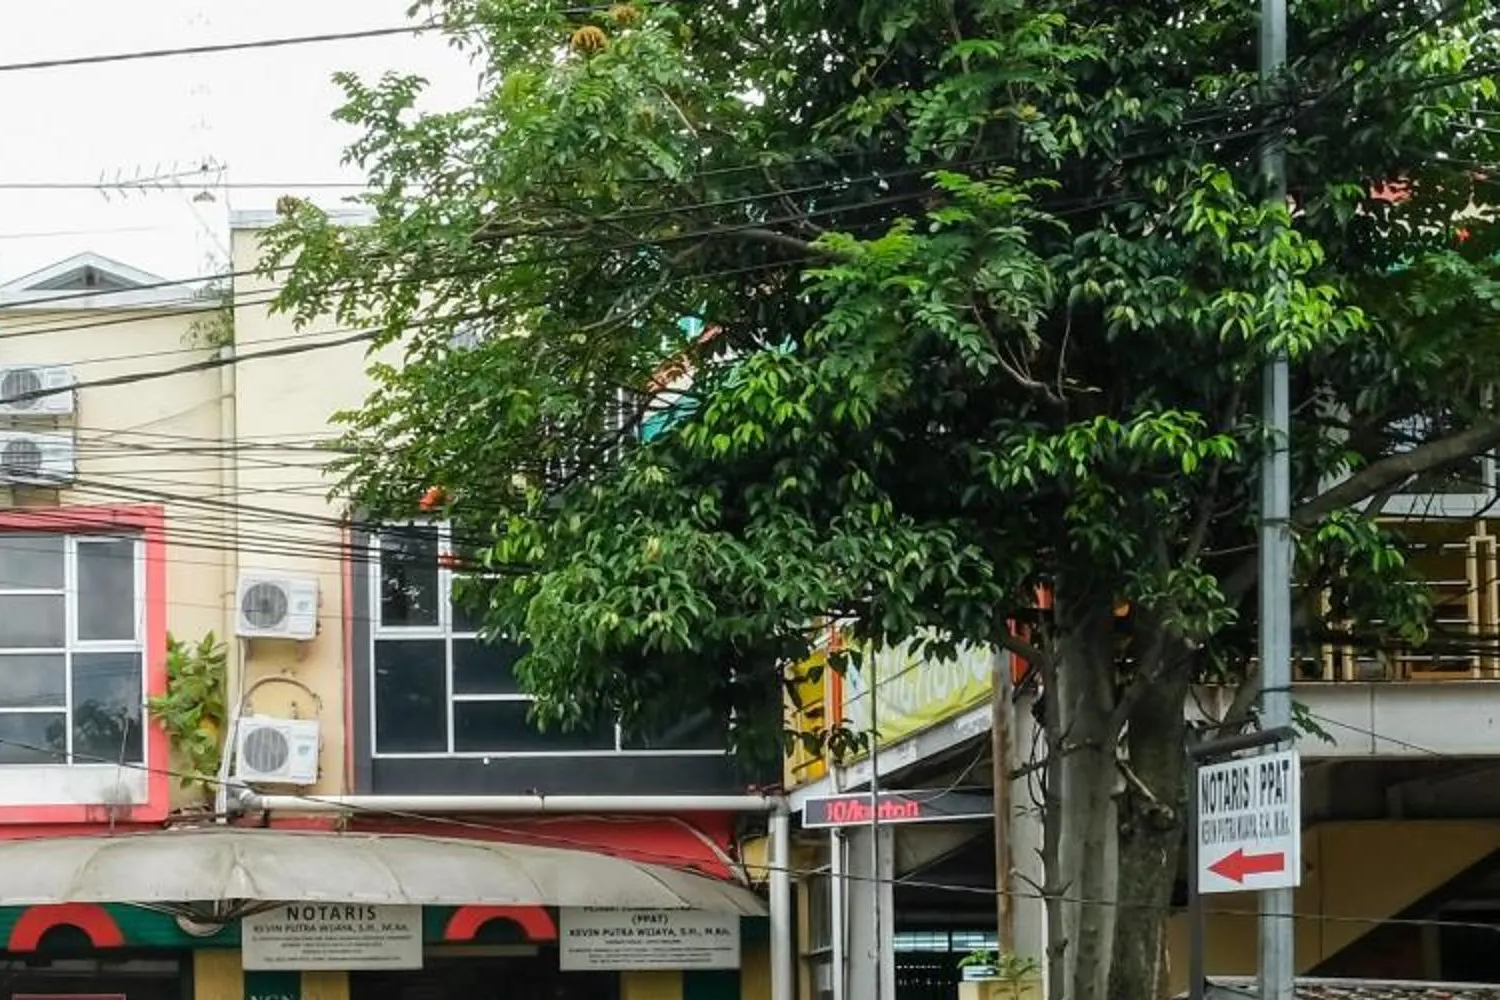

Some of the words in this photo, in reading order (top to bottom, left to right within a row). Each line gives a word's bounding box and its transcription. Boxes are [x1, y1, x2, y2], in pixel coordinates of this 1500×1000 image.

[1201, 766, 1250, 815] NOTARIS
[1259, 760, 1289, 806] PPAT
[287, 906, 377, 921] NOTARIS
